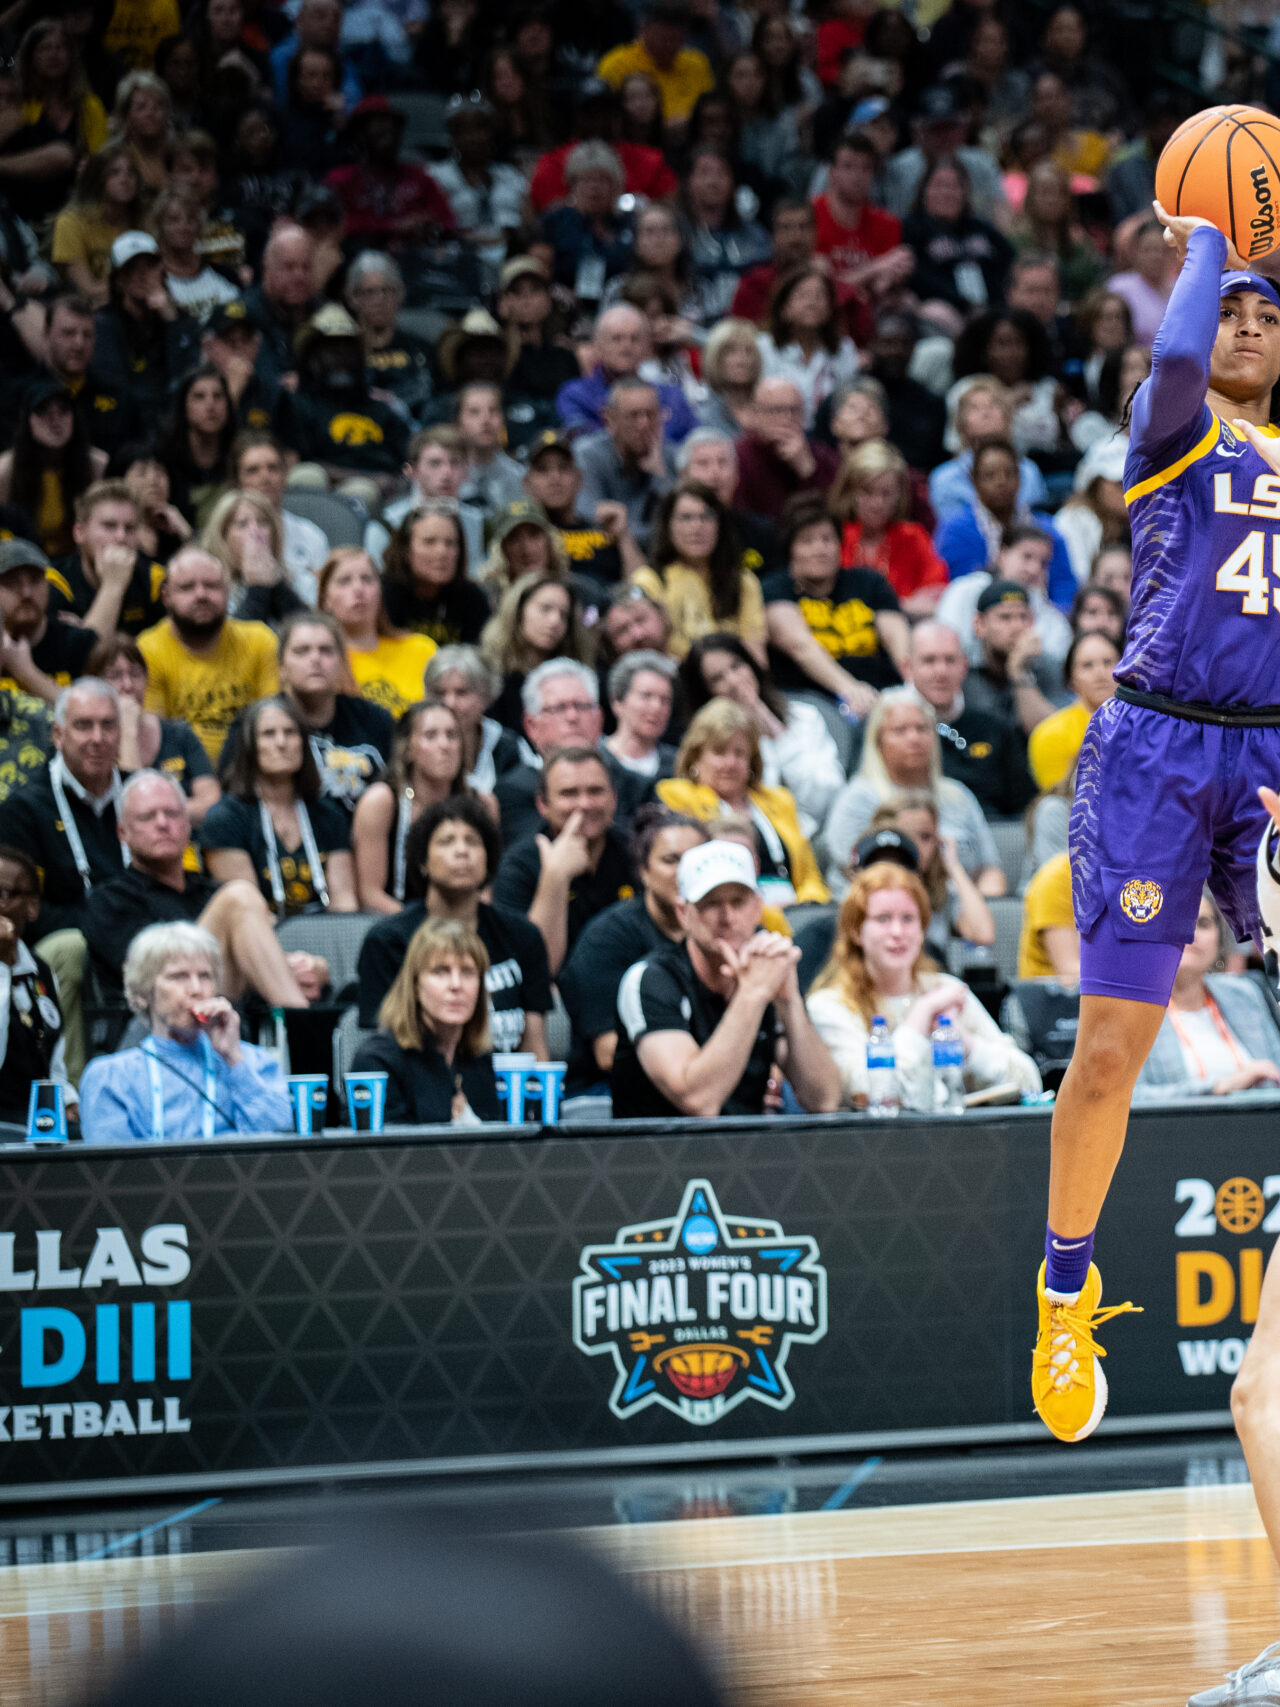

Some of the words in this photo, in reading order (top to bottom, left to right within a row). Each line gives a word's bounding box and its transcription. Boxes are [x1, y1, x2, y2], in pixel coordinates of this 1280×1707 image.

[1248, 163, 1275, 257] Wilson
[648, 1257, 686, 1275] 2023
[687, 1255, 752, 1271] WOMEN'S
[583, 1273, 698, 1338] FINAL
[706, 1271, 815, 1326] FOUR
[20, 1300, 191, 1388] DIII
[673, 1325, 728, 1342] DALLAS
[1177, 1337, 1250, 1376] WO
